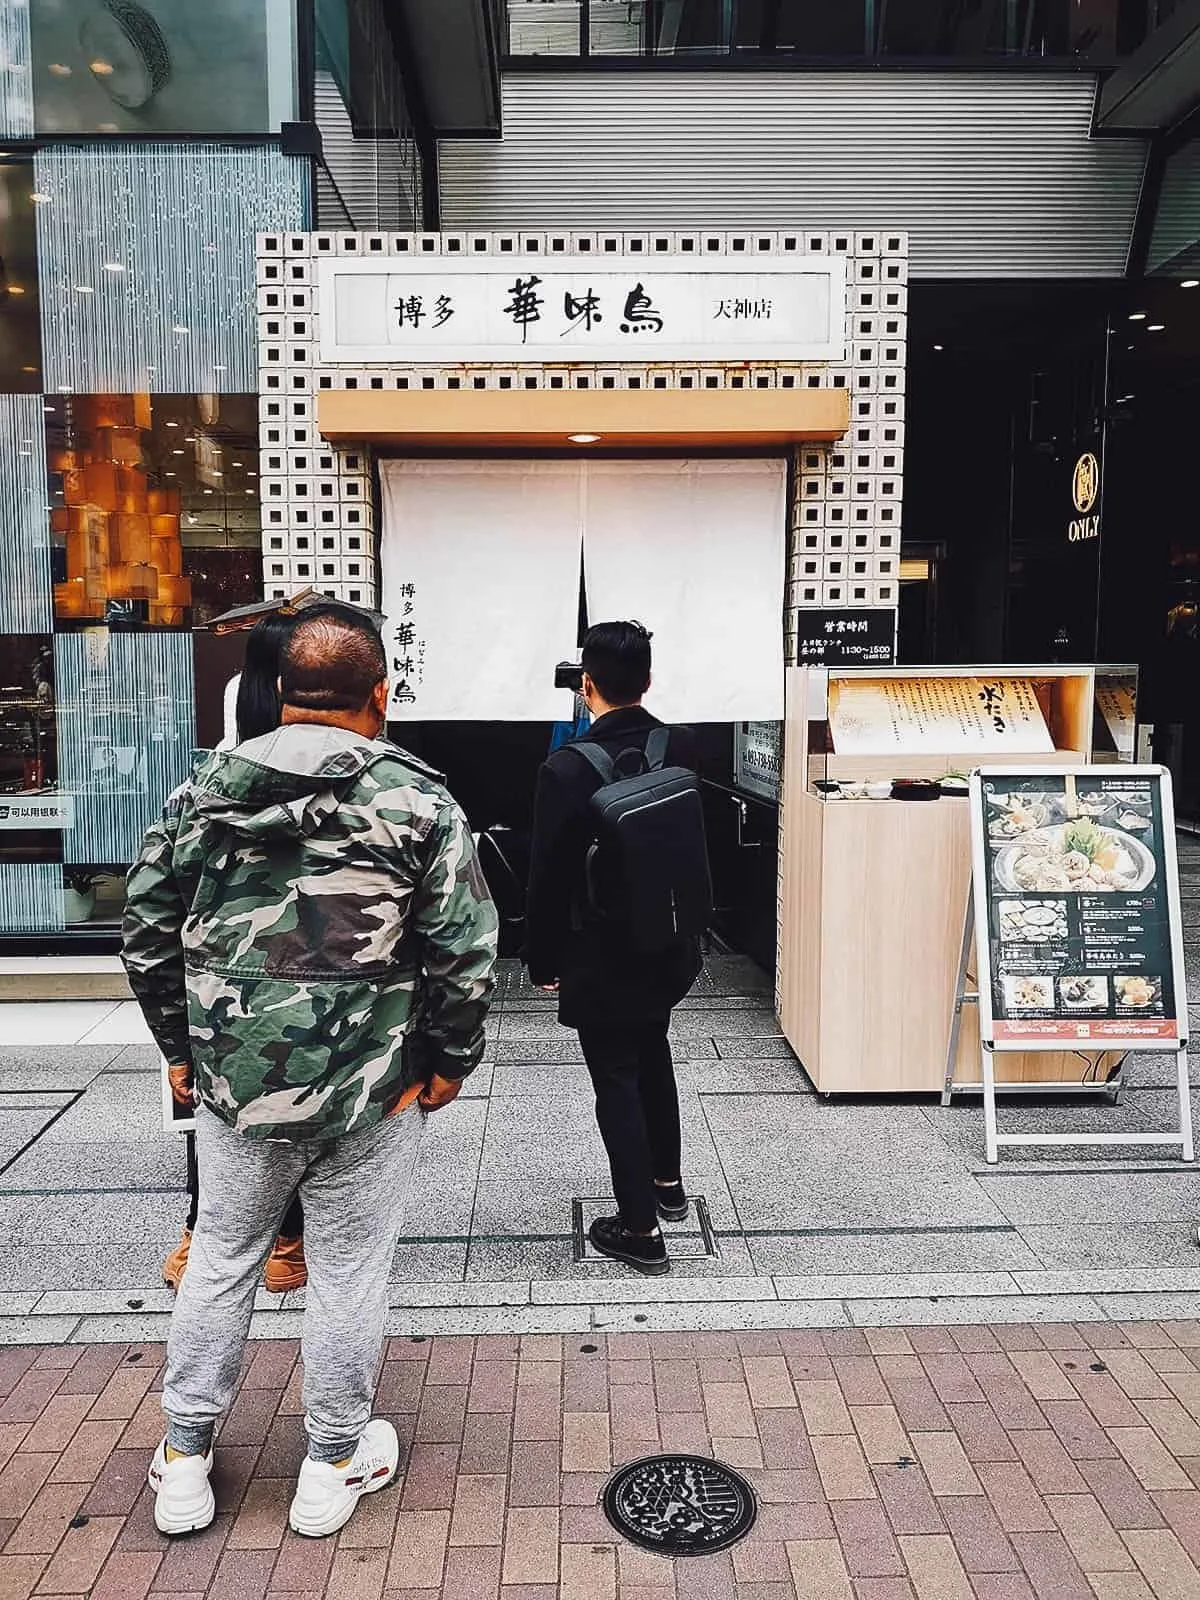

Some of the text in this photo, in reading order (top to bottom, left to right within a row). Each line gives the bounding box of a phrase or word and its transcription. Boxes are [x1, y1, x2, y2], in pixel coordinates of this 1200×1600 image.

[394, 275, 773, 344] 博多 華味鳥 天神店
[1068, 514, 1100, 542] ONLY
[392, 583, 416, 703] 博多 華味鳥
[824, 620, 868, 633] 営業時間
